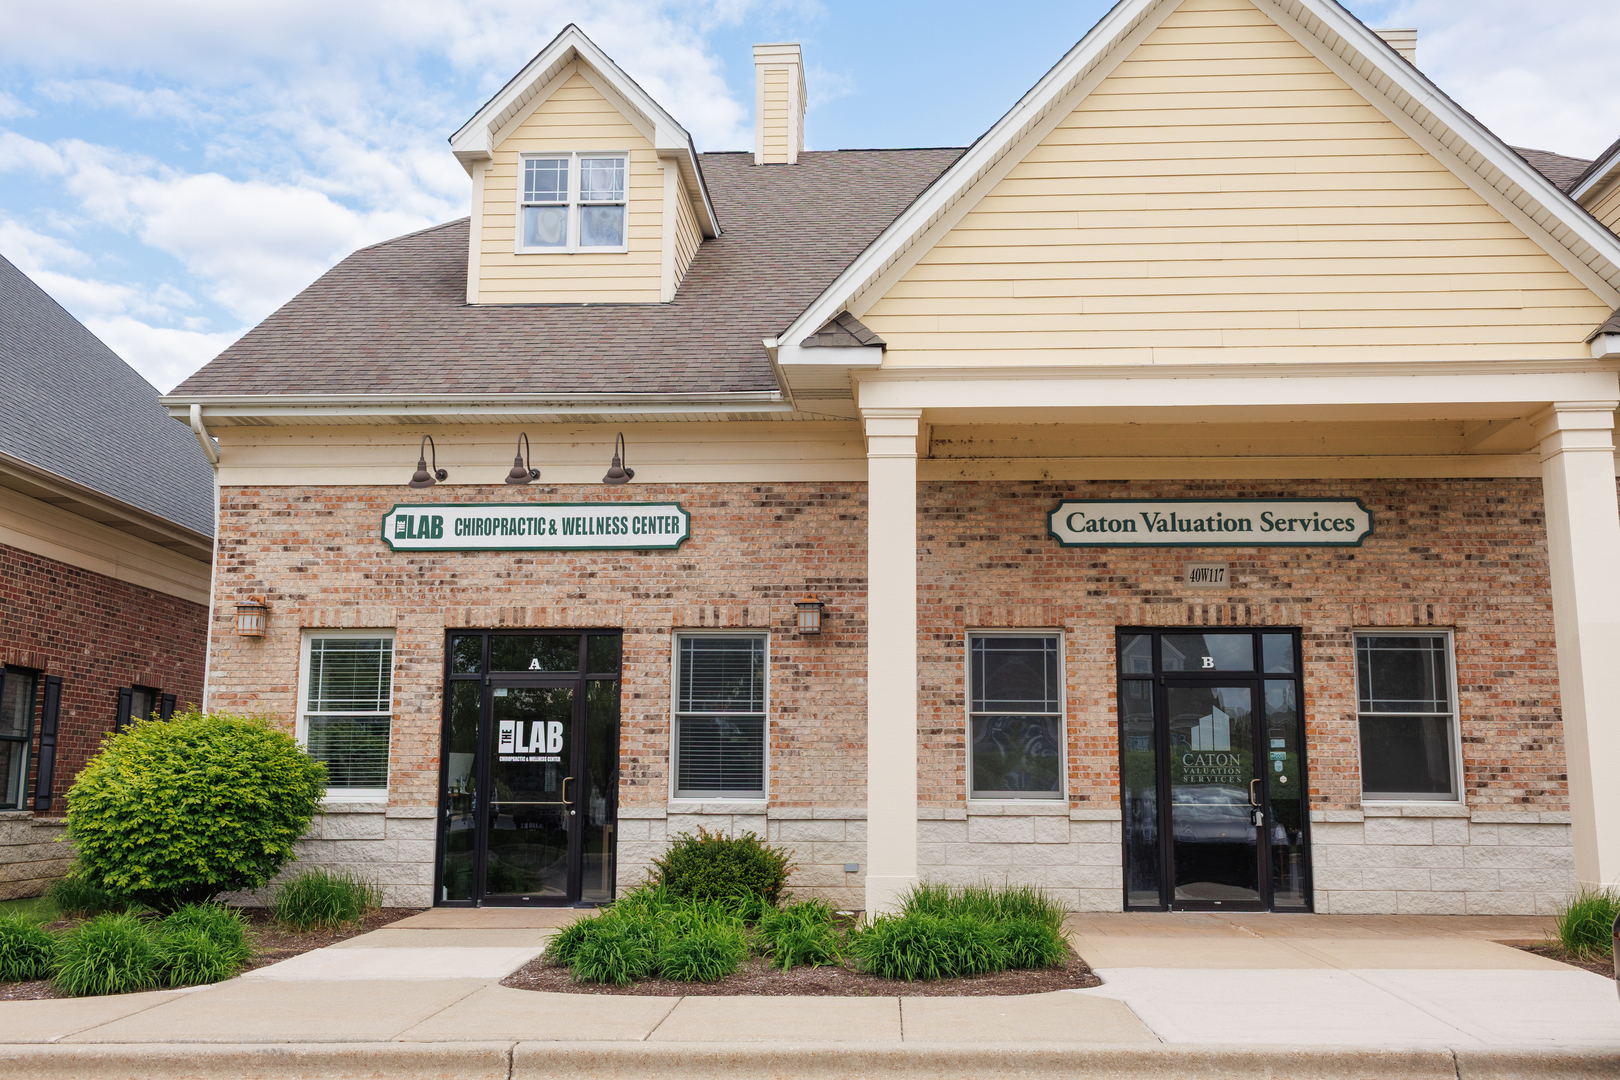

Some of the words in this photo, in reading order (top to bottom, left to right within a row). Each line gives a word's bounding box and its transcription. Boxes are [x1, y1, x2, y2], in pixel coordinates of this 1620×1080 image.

[396, 520, 406, 533] THE
[406, 514, 444, 539] LAB
[454, 517, 546, 537] CHIROPRACTIC
[549, 519, 558, 536] &
[562, 516, 628, 536] WELLNESS
[632, 515, 680, 535] CENTER
[1065, 511, 1138, 533] Caton
[1139, 511, 1254, 533] Valuation
[1260, 511, 1356, 532] Services
[1189, 567, 1225, 583] 40W117
[528, 658, 541, 670] A
[1201, 656, 1214, 669] B
[501, 729, 512, 744] THE
[515, 721, 563, 753] LAB
[1182, 753, 1240, 766] CATON
[1183, 767, 1241, 775] VALUATION
